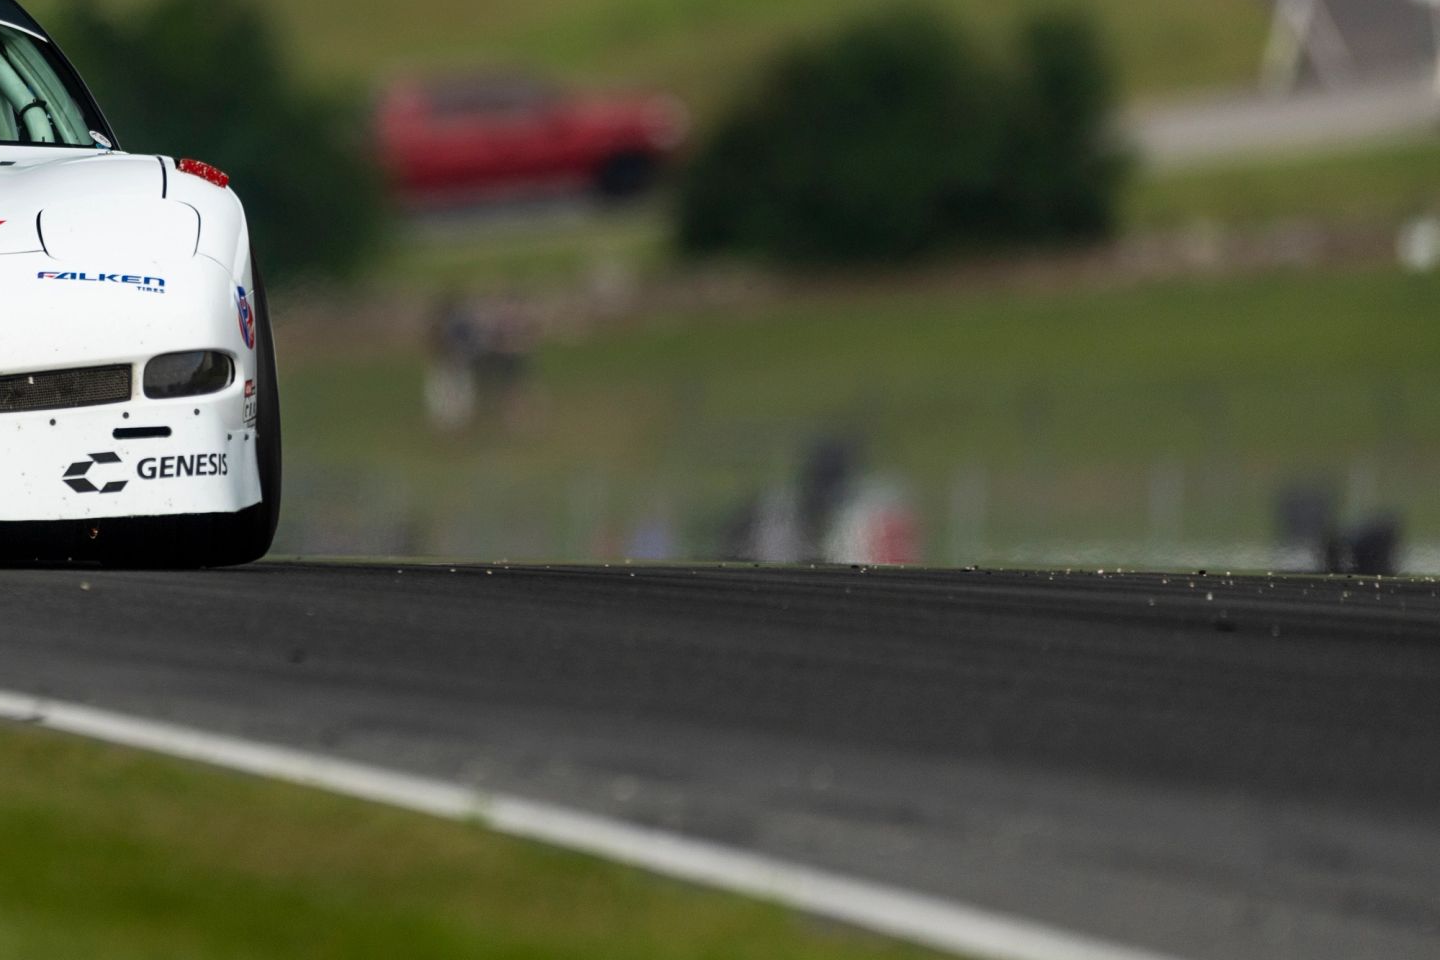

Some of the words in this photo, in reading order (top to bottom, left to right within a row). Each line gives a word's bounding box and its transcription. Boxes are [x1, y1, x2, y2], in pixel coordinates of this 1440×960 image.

[37, 271, 165, 287] FALKEN
[136, 286, 165, 294] TIRES
[136, 453, 228, 480] GENESIS
